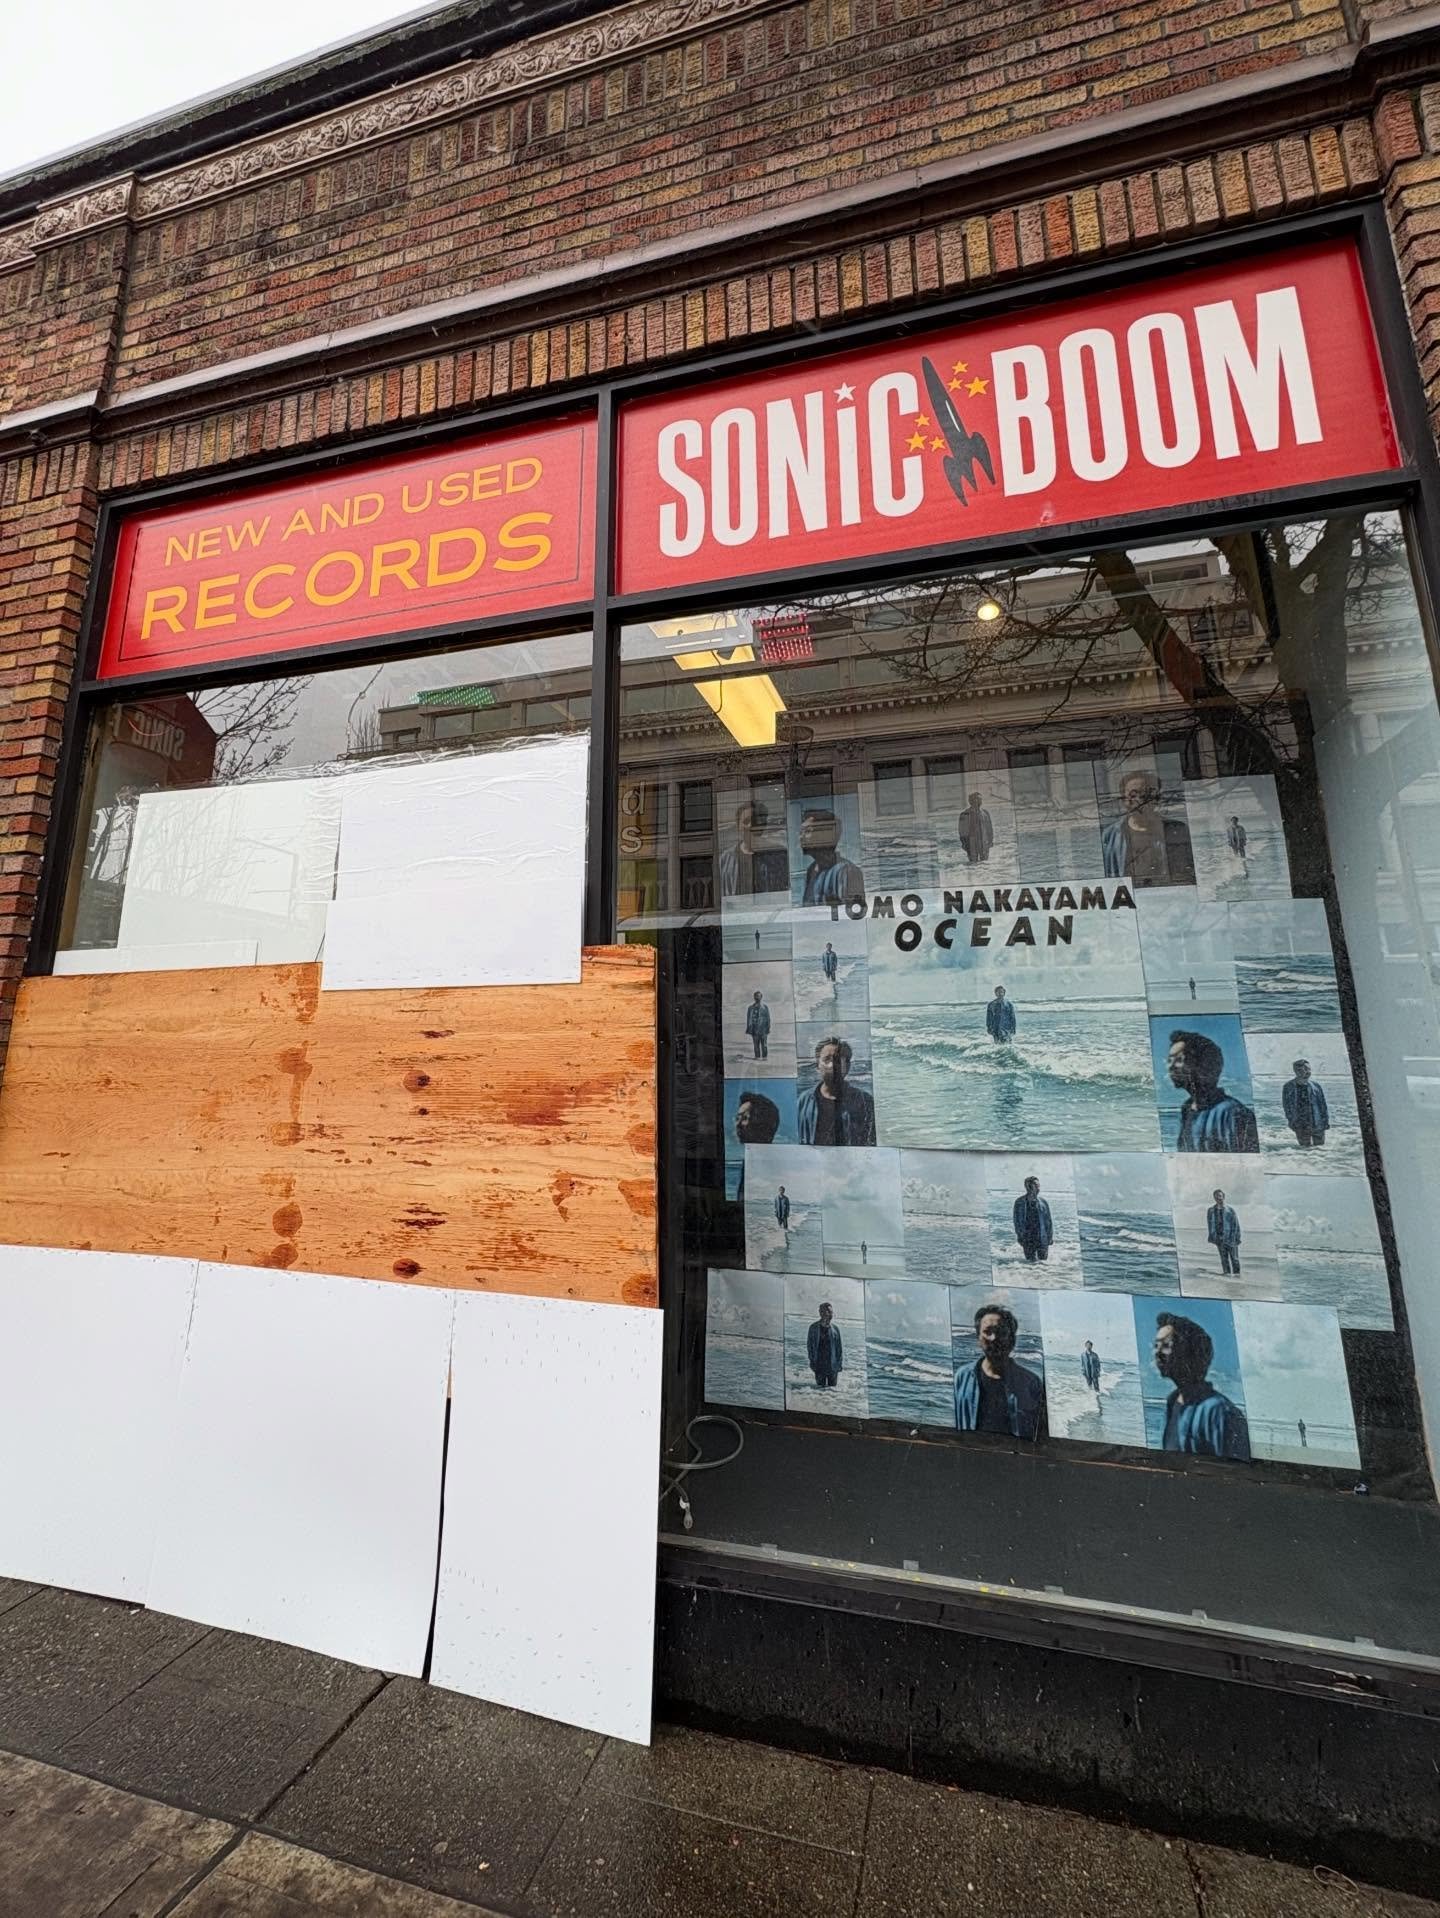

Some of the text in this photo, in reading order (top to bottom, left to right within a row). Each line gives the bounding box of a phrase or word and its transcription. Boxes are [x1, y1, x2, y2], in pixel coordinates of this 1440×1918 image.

[990, 286, 1323, 497] BOOM
[164, 456, 543, 567] NEW AND USED
[140, 511, 553, 640] RECORDS
[824, 885, 1137, 921] TOMO NAKAYAMA
[894, 915, 1074, 952] OCEAN
